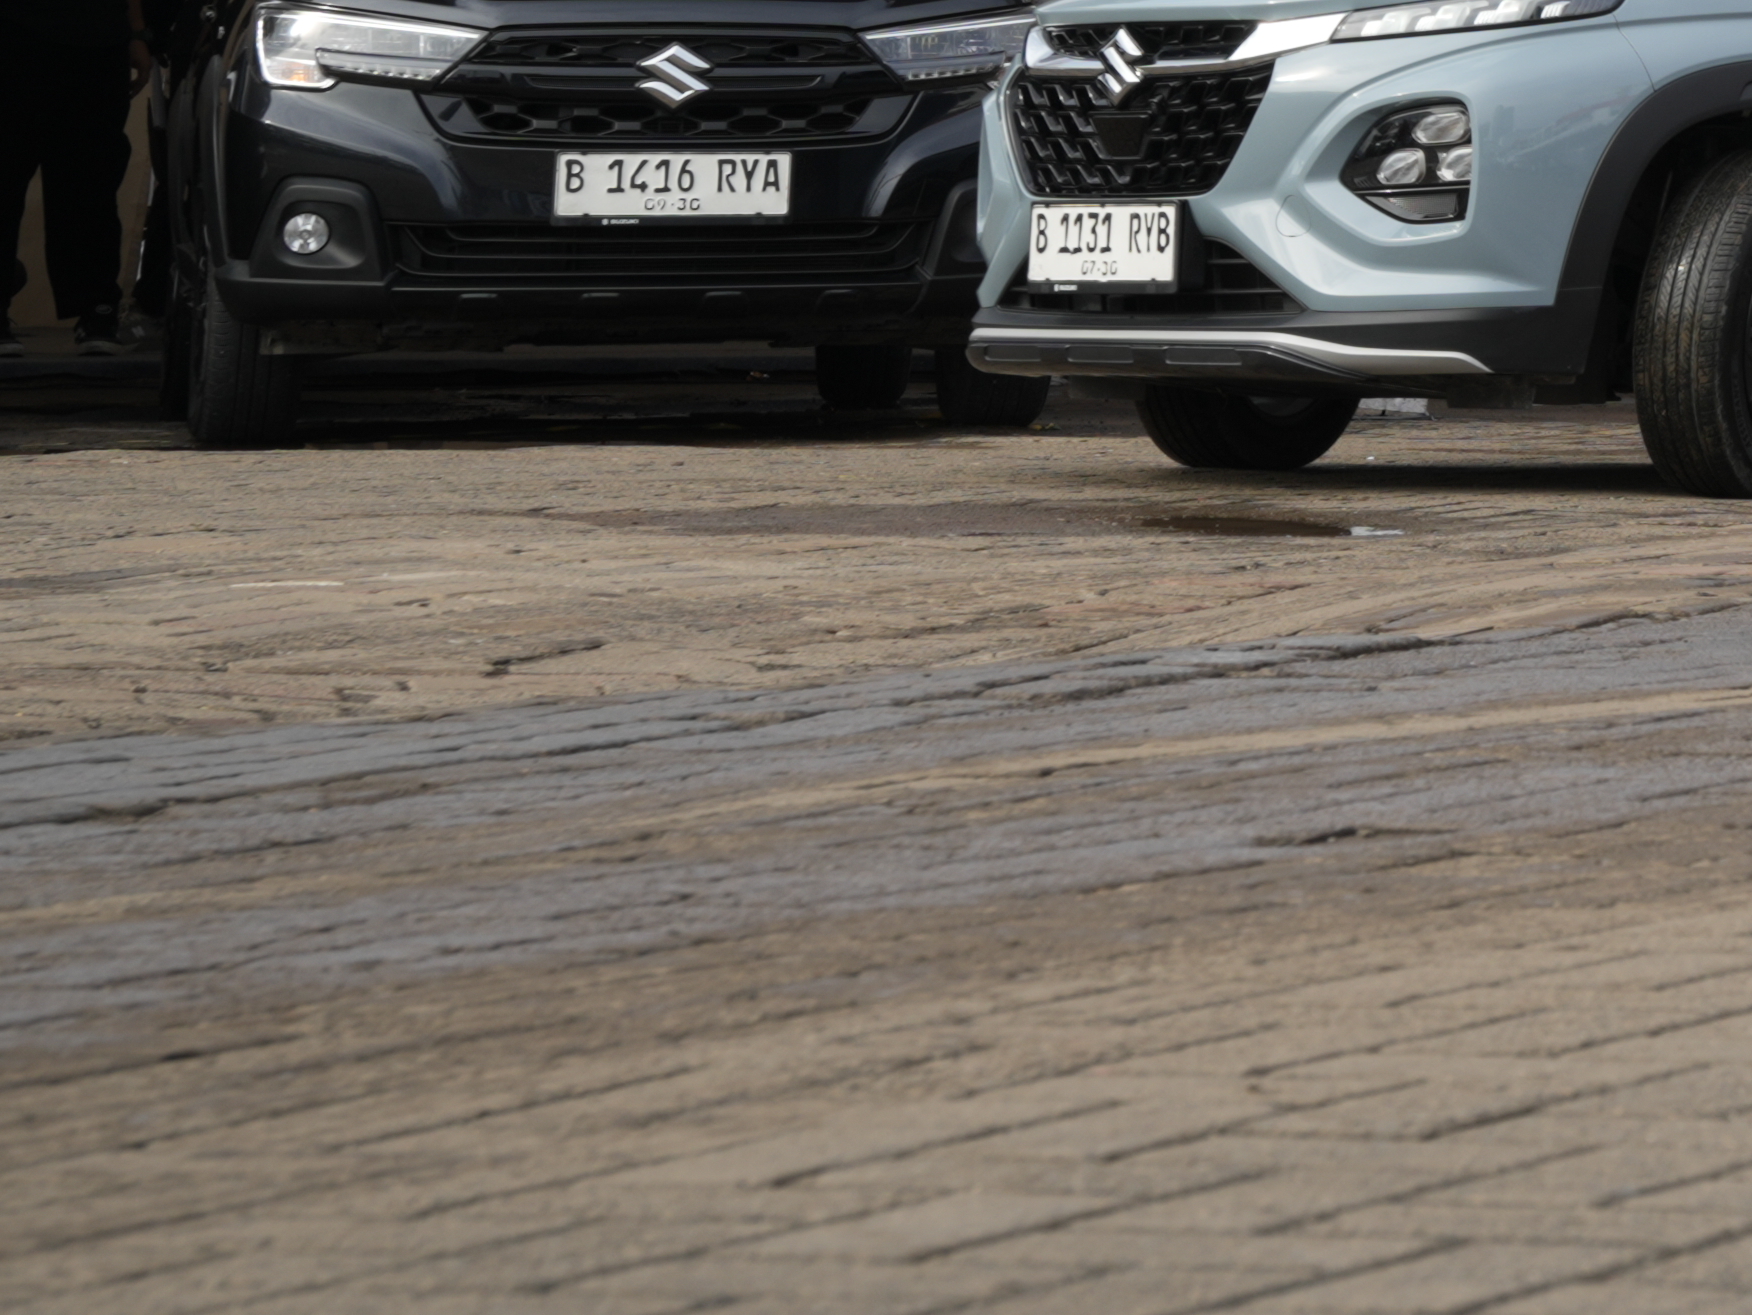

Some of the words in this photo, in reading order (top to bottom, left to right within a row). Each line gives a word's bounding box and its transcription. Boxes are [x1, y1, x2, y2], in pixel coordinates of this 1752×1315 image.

[564, 158, 585, 193] B
[606, 158, 695, 194] 1416
[716, 158, 781, 193] RYA
[1036, 213, 1048, 254] B
[1057, 212, 1113, 255] 1131
[1128, 211, 1171, 254] RYB
